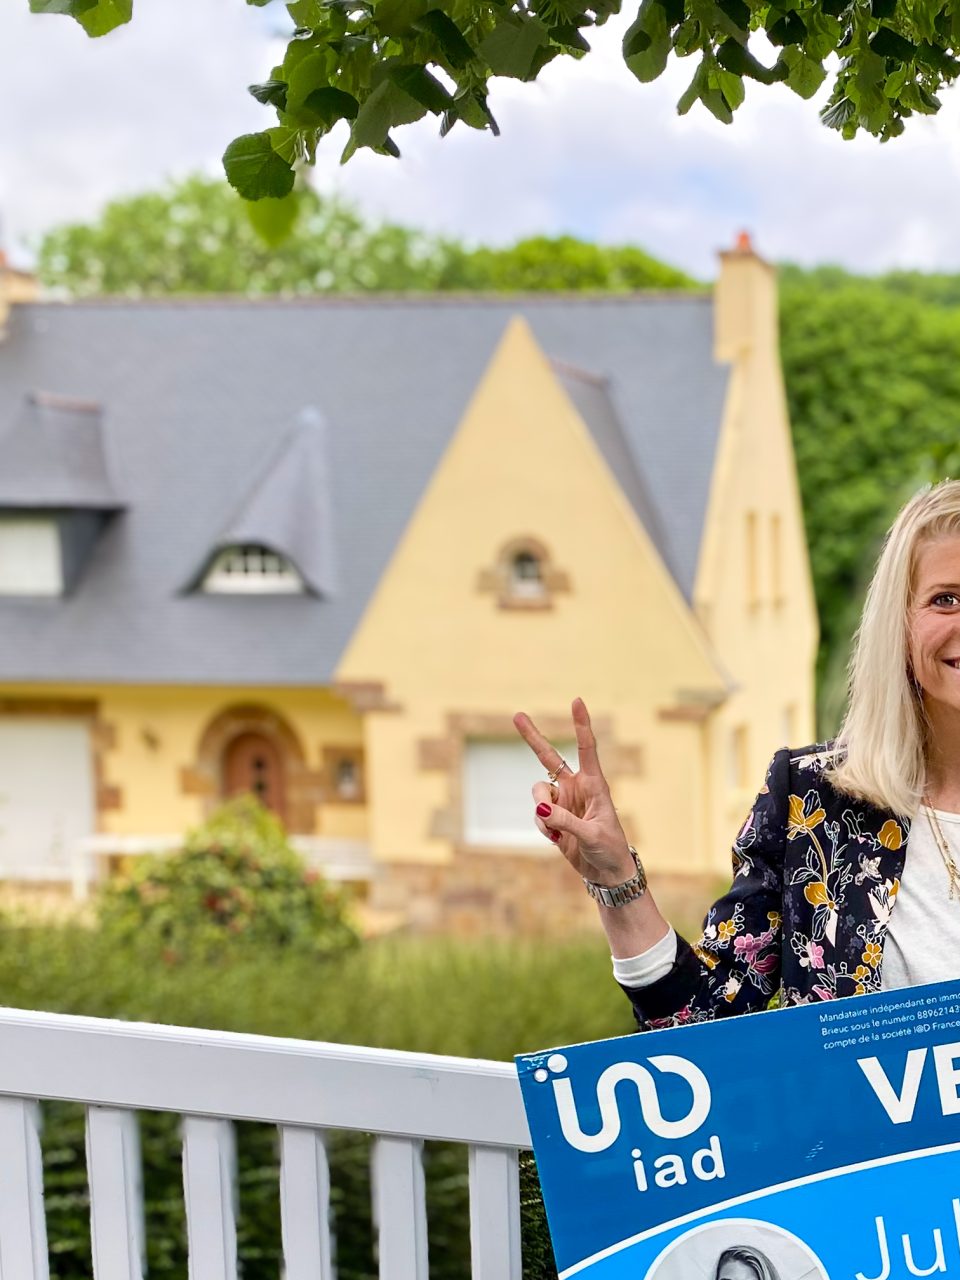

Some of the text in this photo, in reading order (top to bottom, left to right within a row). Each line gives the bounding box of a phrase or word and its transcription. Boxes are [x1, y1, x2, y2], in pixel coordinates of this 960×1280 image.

[819, 1009, 868, 1023] Mandataire
[870, 999, 924, 1014] indépendant
[821, 1026, 849, 1036] Brieuc
[850, 1023, 871, 1031] sous
[881, 1014, 915, 1025] numéro
[823, 1038, 857, 1050] compte
[881, 1027, 911, 1040] société
[913, 1023, 931, 1033] I@D
[932, 1019, 960, 1031] France
[631, 1135, 726, 1192] iad
